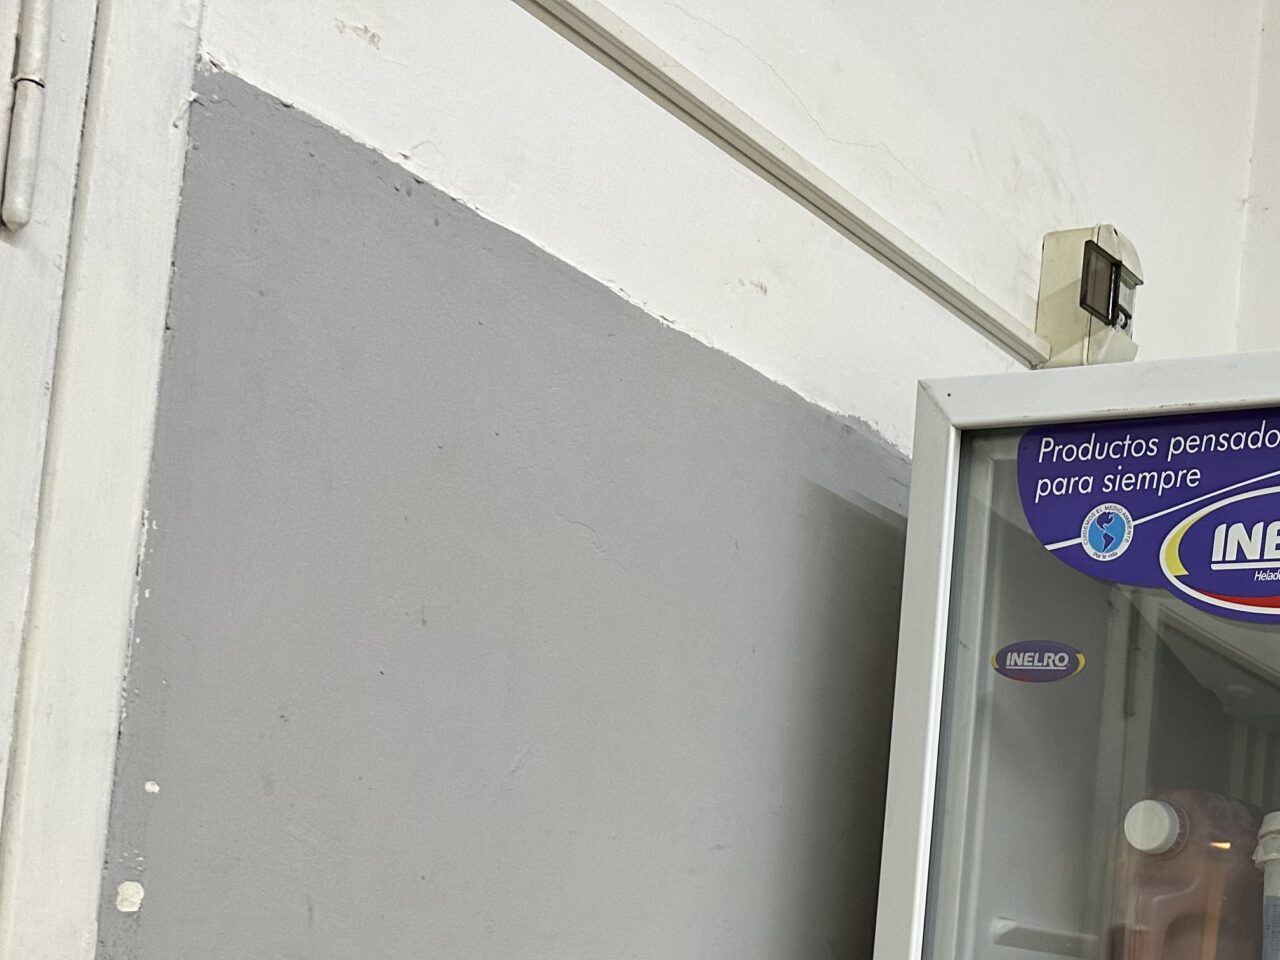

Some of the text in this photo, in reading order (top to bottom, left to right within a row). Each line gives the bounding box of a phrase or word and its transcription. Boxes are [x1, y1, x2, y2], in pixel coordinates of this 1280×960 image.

[1038, 433, 1159, 463] Productos
[1035, 465, 1201, 503] para siempre
[1005, 652, 1069, 668] INELRO
